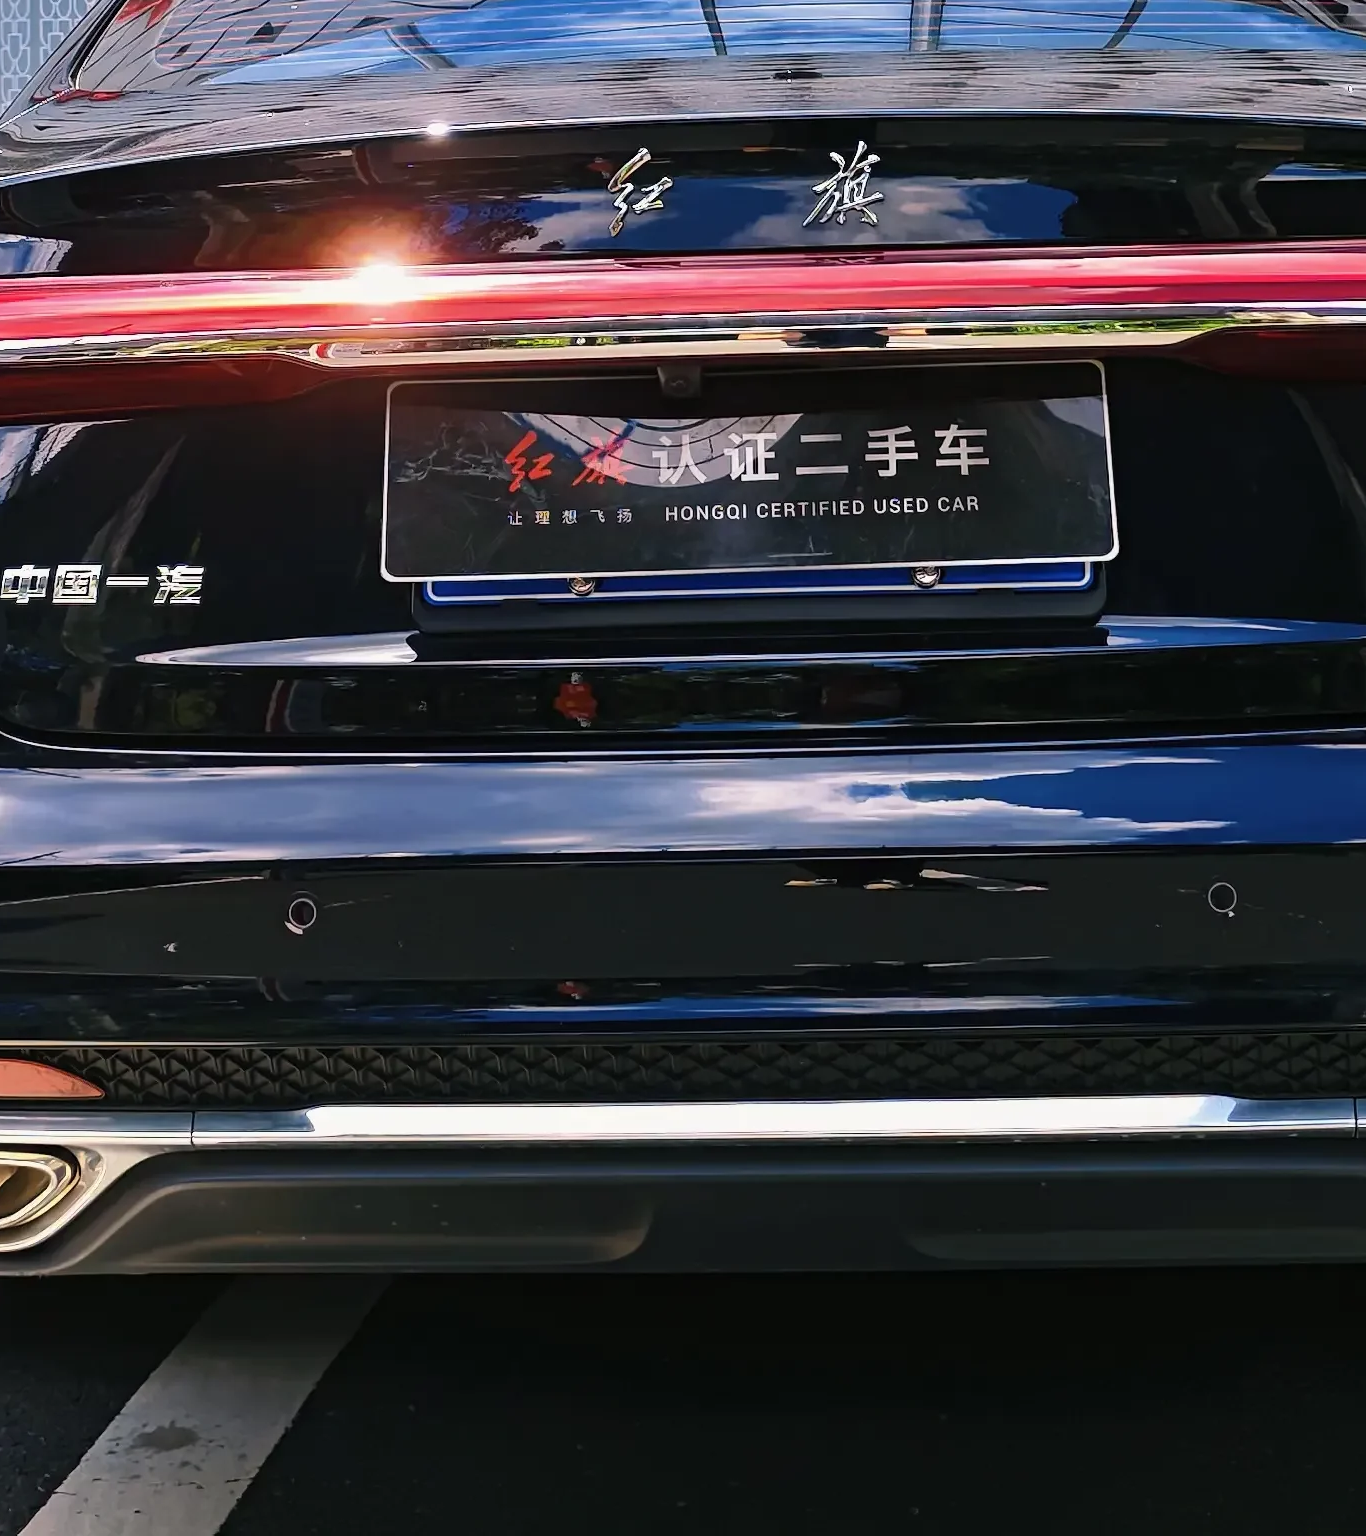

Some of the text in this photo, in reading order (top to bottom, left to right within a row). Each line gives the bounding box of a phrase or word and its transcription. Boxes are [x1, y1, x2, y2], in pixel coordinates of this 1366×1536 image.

[608, 140, 884, 237] 红旗
[505, 424, 989, 493] 红旗 认证二手车
[508, 508, 632, 526] 让理想飞扬
[665, 495, 979, 522] HONGQI CERTIFIED USED CAR
[0, 564, 206, 605] 中国一汽
